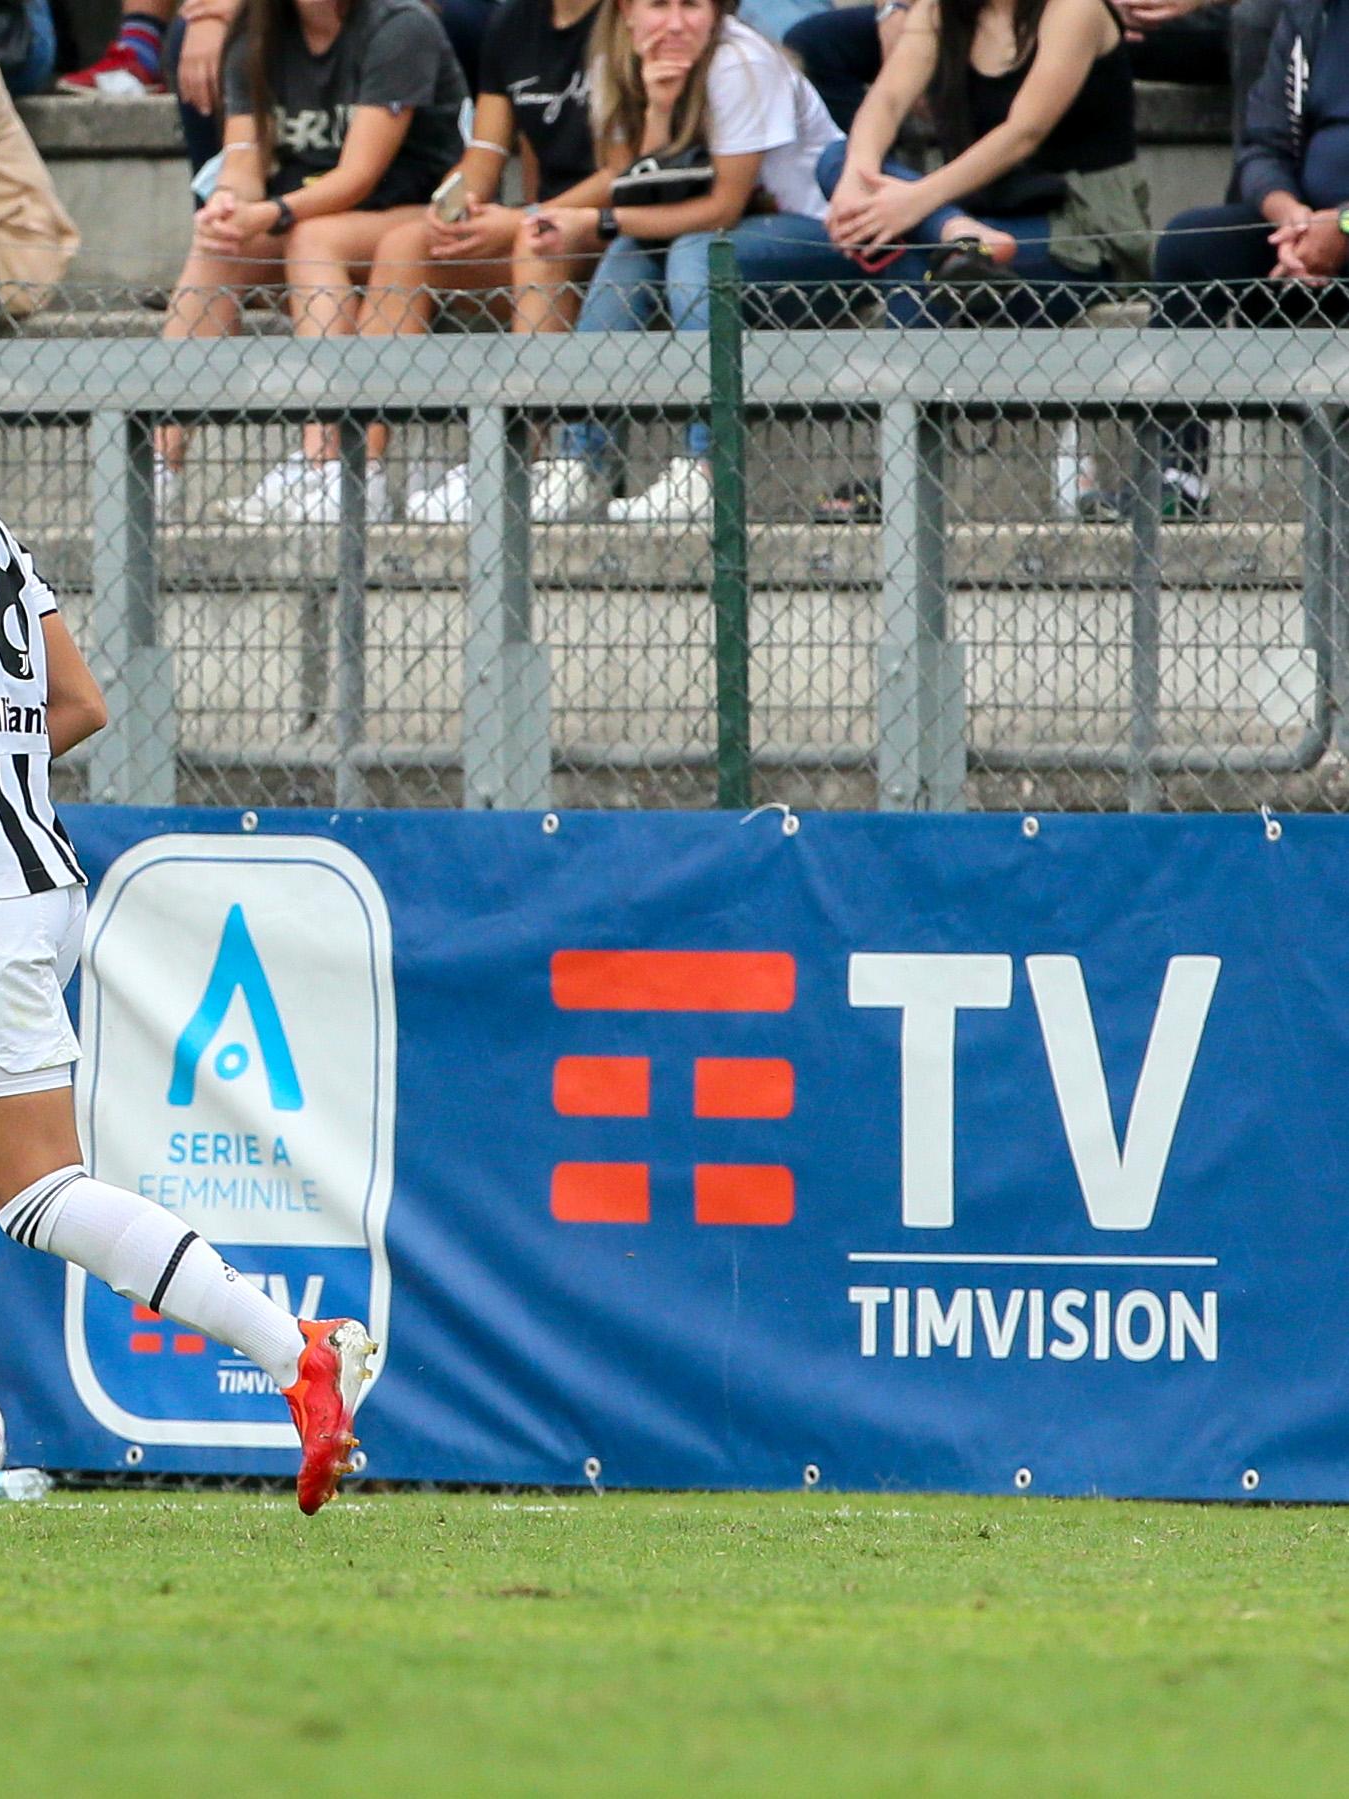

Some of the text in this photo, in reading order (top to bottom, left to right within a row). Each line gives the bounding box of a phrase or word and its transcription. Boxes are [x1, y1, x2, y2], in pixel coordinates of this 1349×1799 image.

[848, 953, 1221, 1230] TV
[168, 1133, 292, 1167] SERIE A
[138, 1174, 323, 1212] FEMMINILE
[848, 1285, 1219, 1362] TIMVISION
